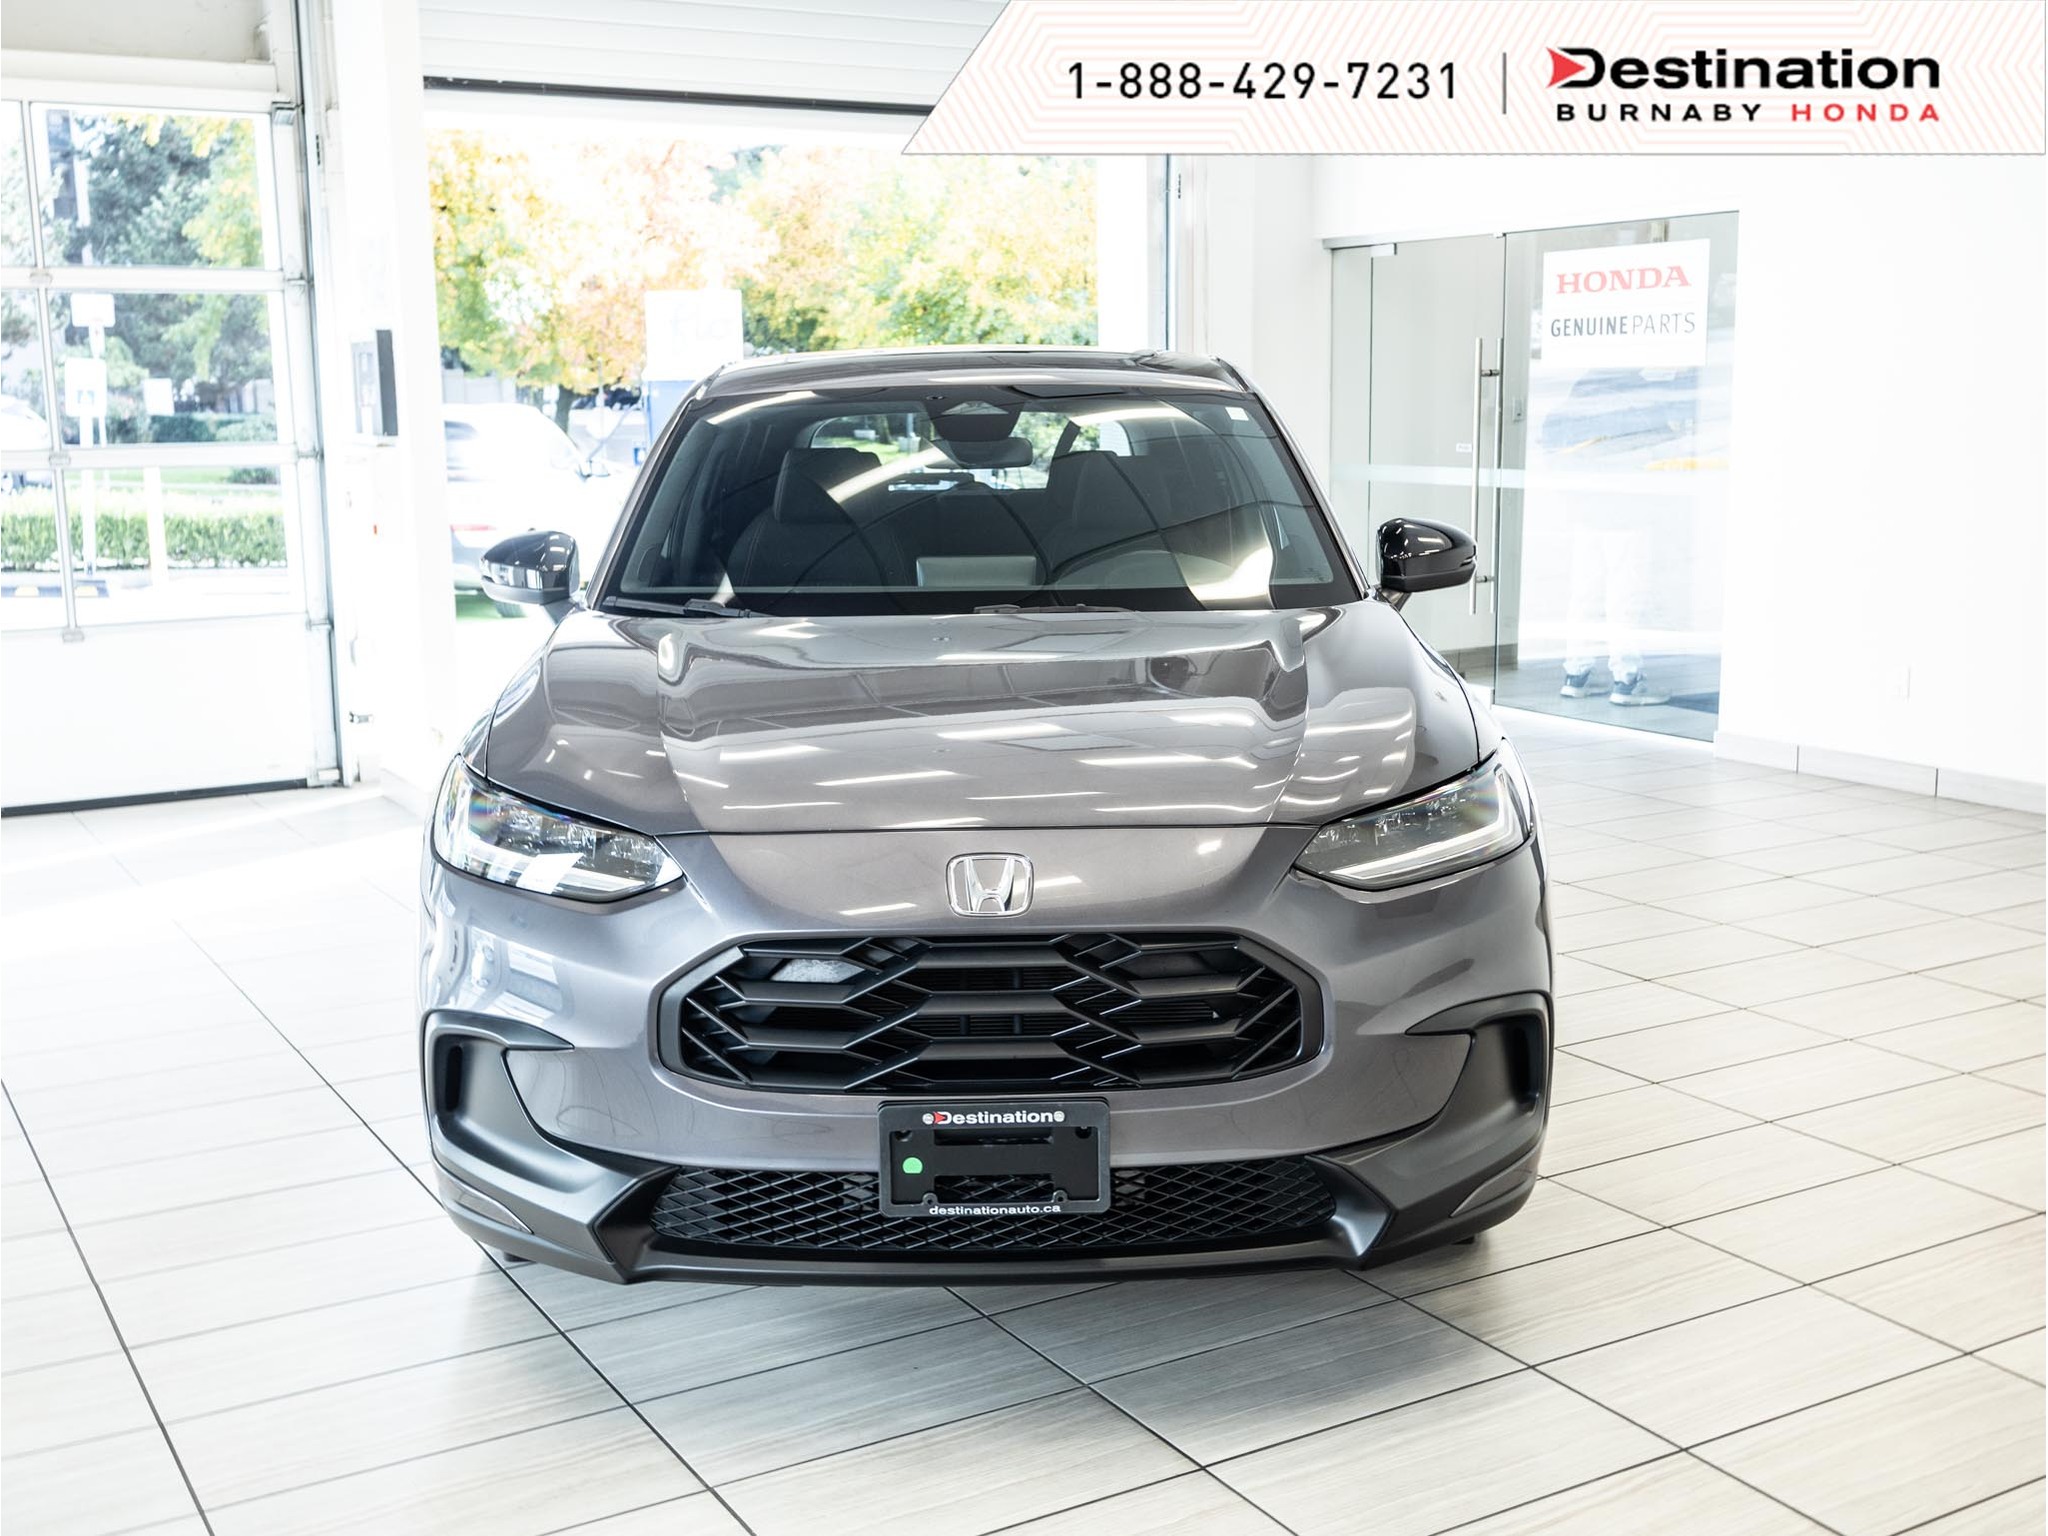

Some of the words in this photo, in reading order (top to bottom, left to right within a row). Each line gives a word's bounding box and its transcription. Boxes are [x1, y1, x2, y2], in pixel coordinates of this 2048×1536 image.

[1556, 265, 1692, 295] HONDA
[934, 1109, 1054, 1126] Destination
[928, 1203, 1062, 1217] destinationauto.ca
